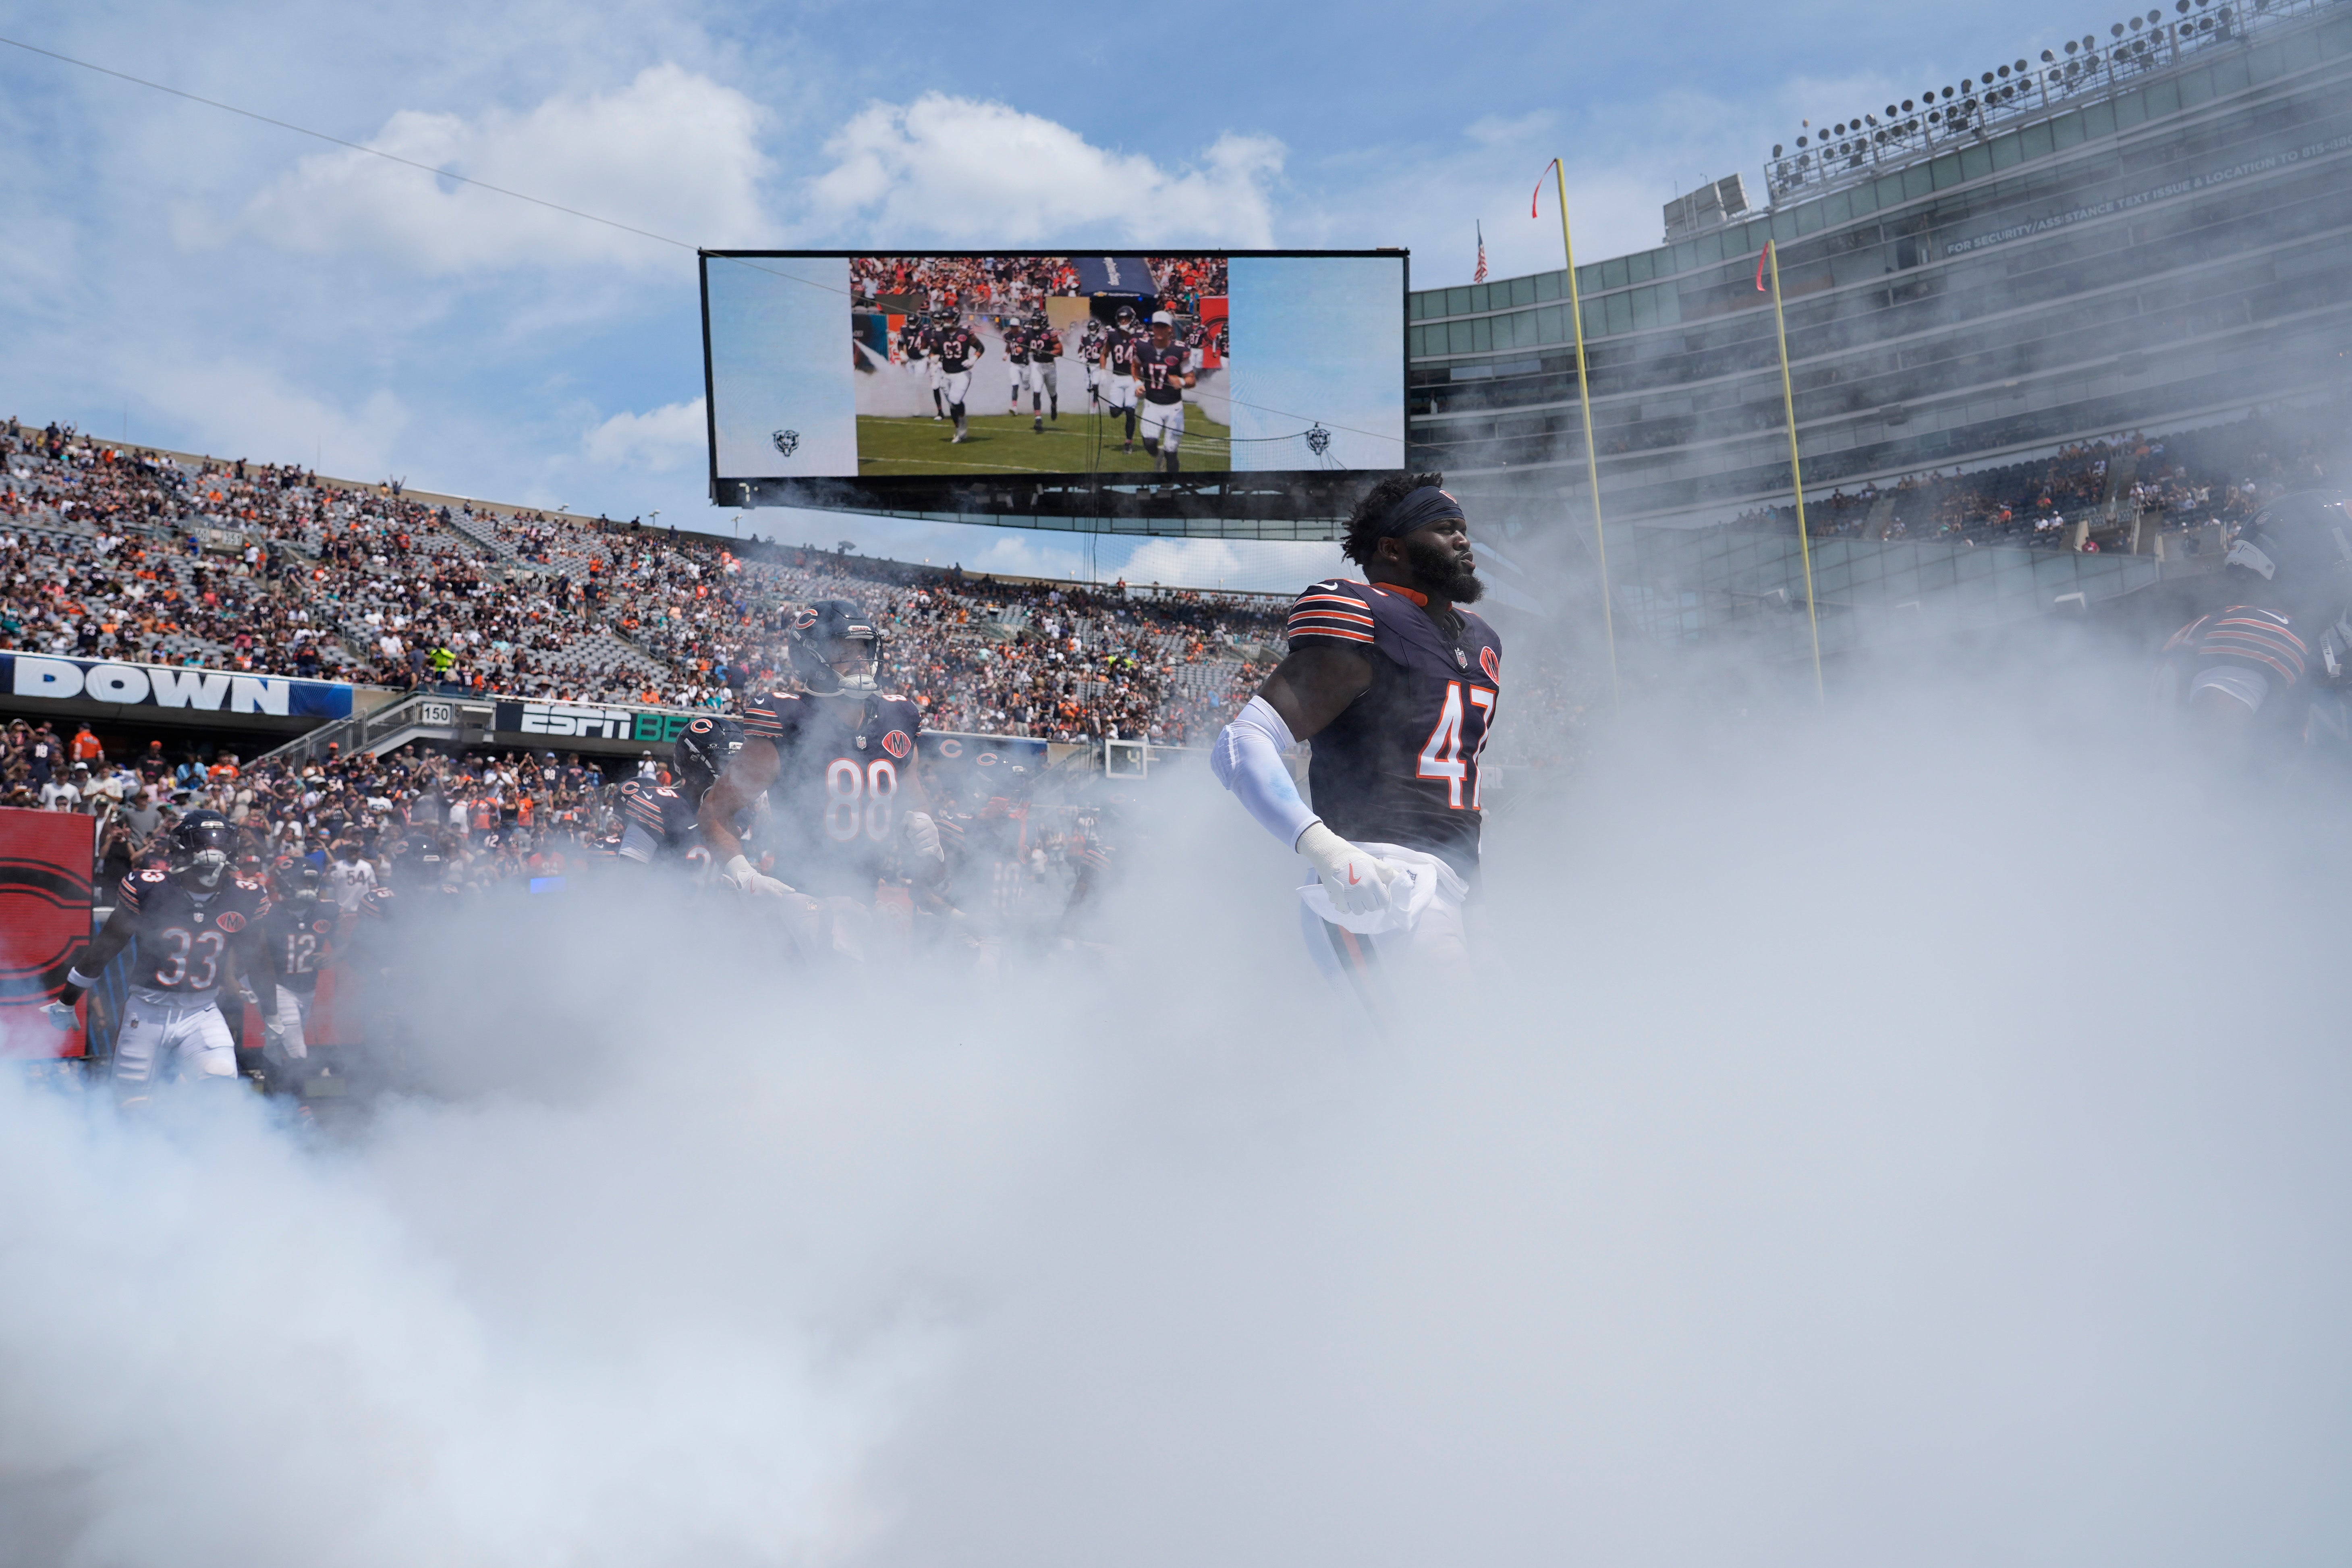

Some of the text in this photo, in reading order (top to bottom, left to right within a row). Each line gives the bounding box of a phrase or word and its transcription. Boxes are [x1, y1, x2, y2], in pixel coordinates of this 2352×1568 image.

[1947, 241, 1972, 254] FOR
[1974, 201, 2115, 249] SECURITY/ASSISTANCE
[2117, 193, 2149, 209] TEXT
[2153, 180, 2191, 199] ISSUE
[2194, 177, 2203, 188] &
[2205, 157, 2276, 185] LOCATION
[2279, 150, 2298, 164] TO
[907, 336, 921, 350] 74
[943, 340, 962, 359] 63
[1189, 334, 1199, 345] 87
[1114, 344, 1133, 364] 84
[1149, 363, 1168, 389] 17
[14, 656, 290, 716] DOWN
[424, 707, 449, 720] 150
[521, 703, 697, 743] ESPN BE
[35, 744, 48, 758] 18
[1416, 679, 1497, 811] 47
[1127, 749, 1141, 770] 4
[544, 769, 556, 780] 98
[328, 779, 344, 792] 54
[825, 757, 898, 843] 88
[347, 870, 367, 886] 54
[156, 927, 225, 989] 33
[286, 933, 316, 974] 12
